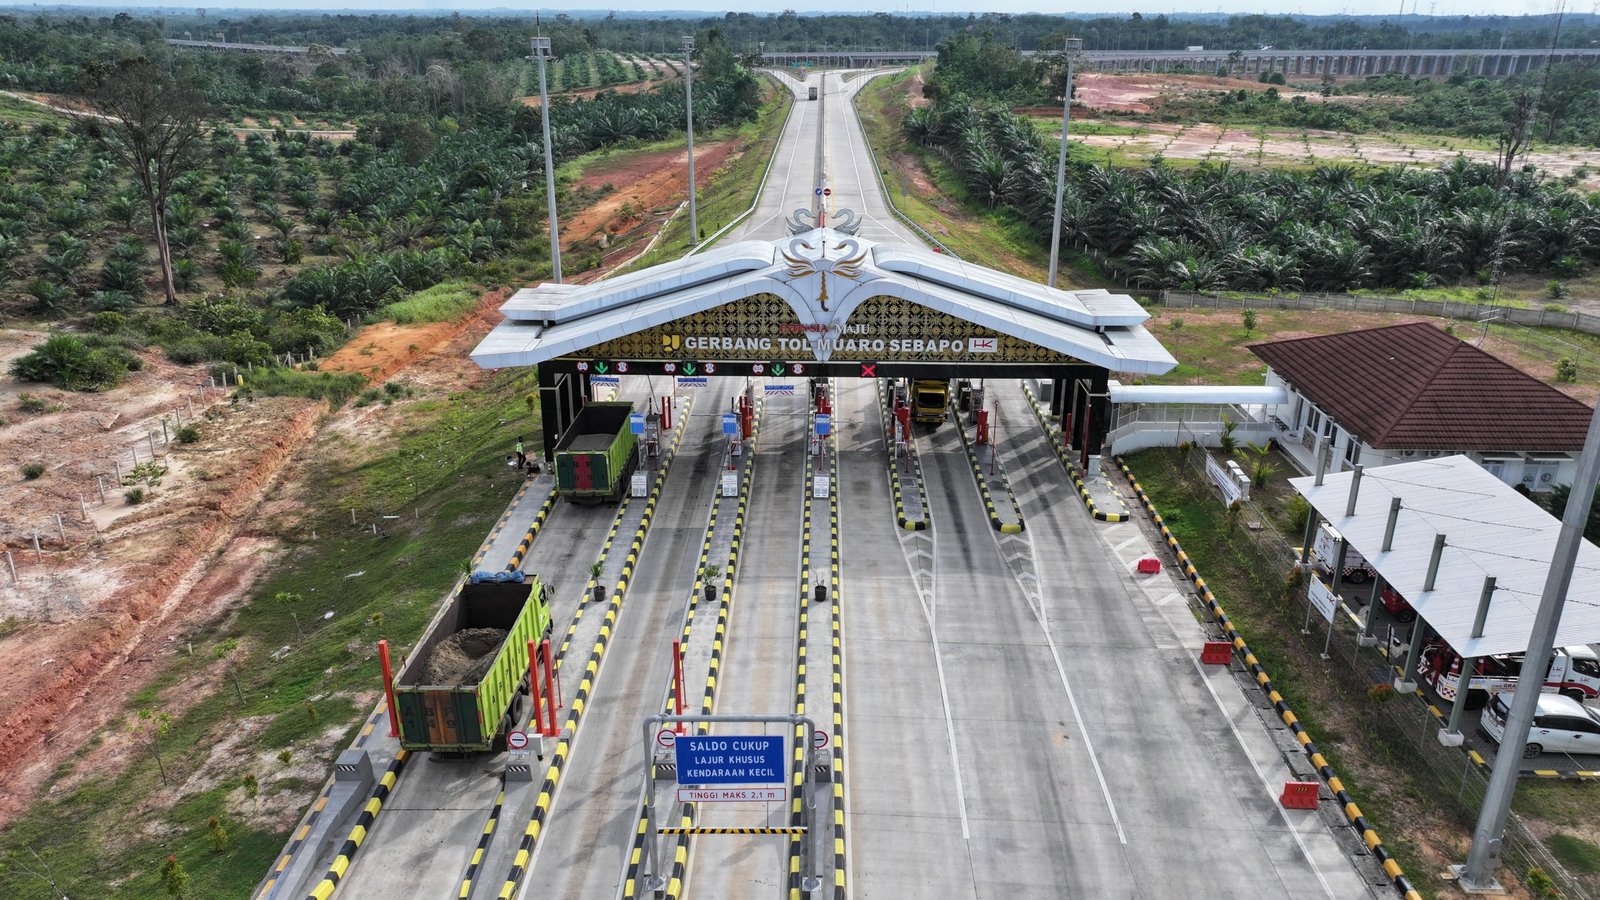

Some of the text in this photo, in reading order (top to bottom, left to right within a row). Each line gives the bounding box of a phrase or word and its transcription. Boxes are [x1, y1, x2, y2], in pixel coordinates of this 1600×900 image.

[835, 323, 870, 335] MAJU
[685, 336, 964, 353] GERBANG TOL MUARO SEBAPO
[689, 741, 770, 751] SALDO CUKUP
[694, 756, 765, 765] LAJUR KHUSUS
[687, 768, 775, 777] KENDARAAN KECIL
[751, 791, 763, 800] 2,1
